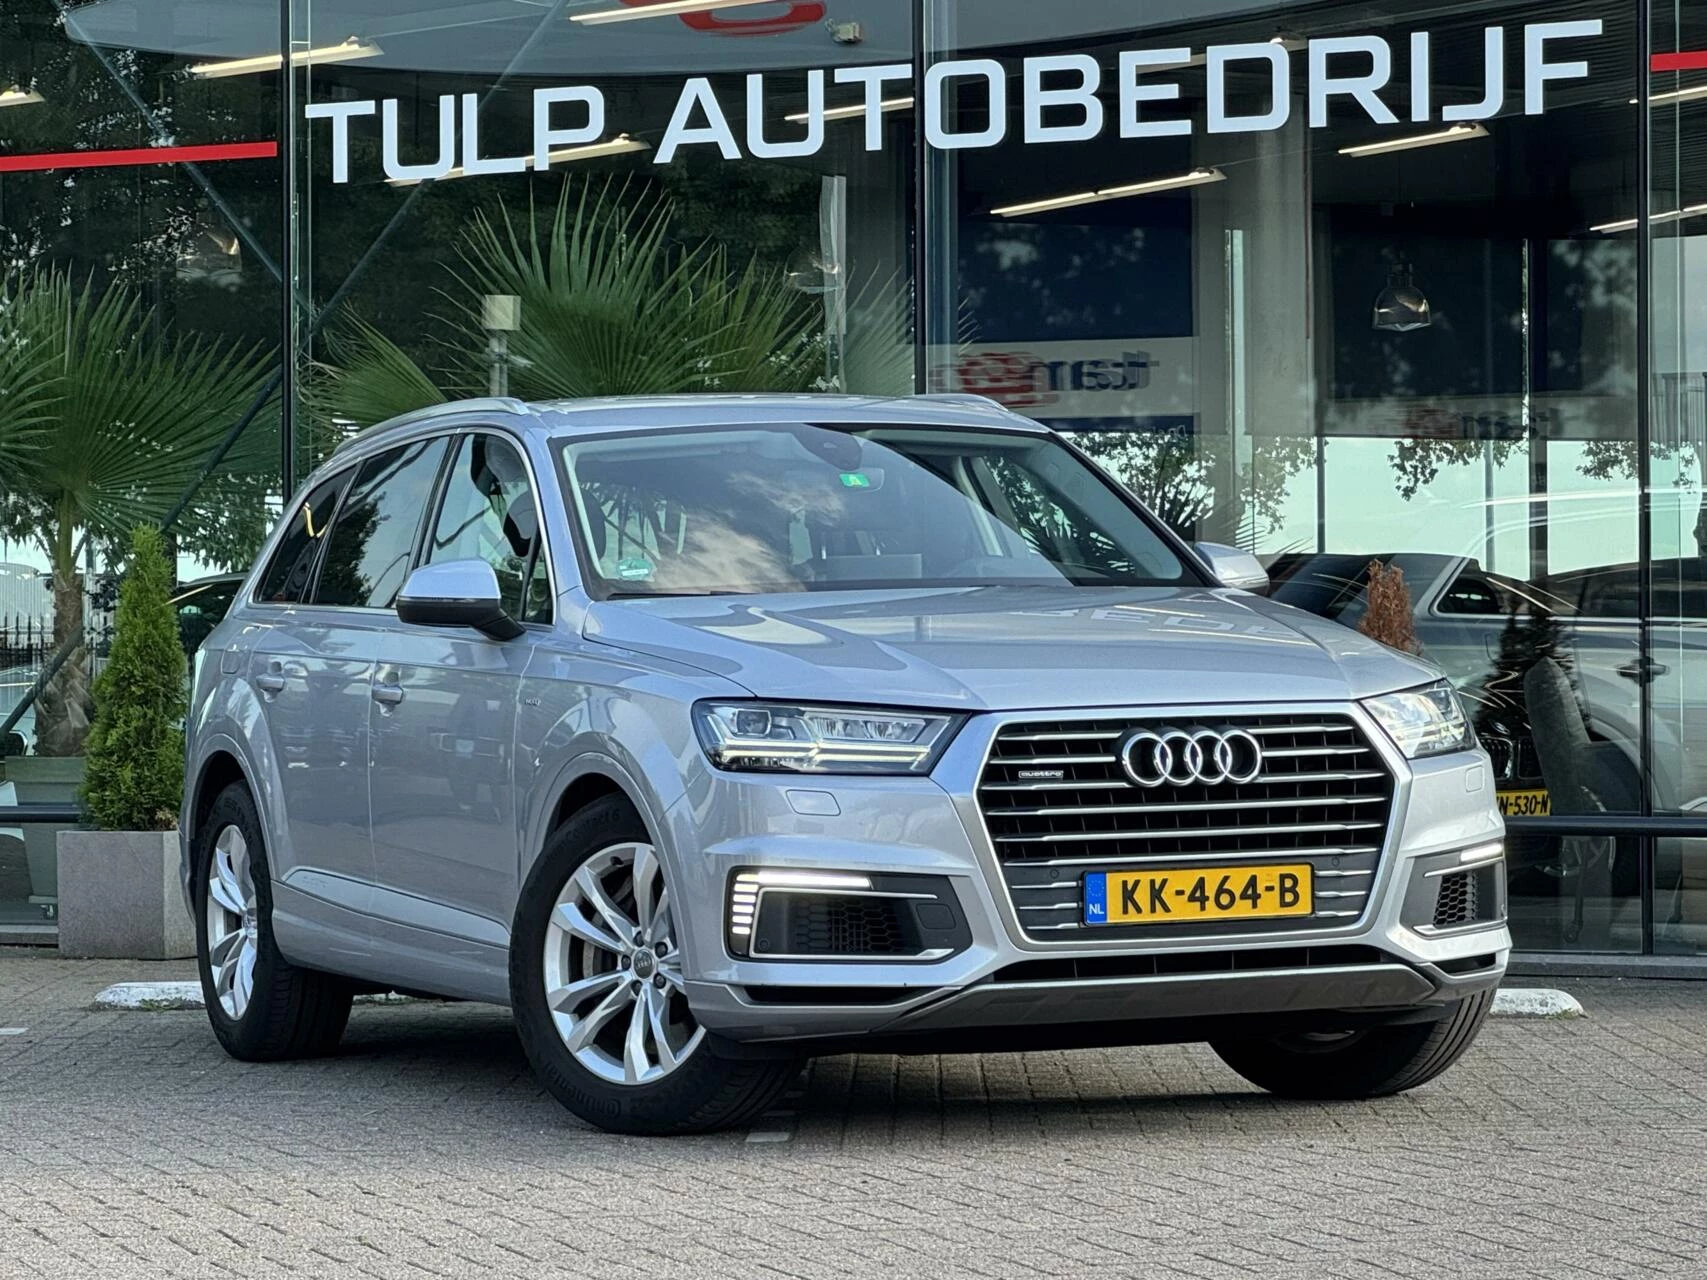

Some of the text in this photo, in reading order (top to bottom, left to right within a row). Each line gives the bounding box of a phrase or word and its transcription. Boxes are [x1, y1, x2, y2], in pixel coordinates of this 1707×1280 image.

[305, 19, 1602, 183] TULP AUTOBEDRIJF
[1496, 793, 1549, 815] N-530-N
[1089, 904, 1105, 915] NL
[1121, 872, 1300, 916] KK-464-B
